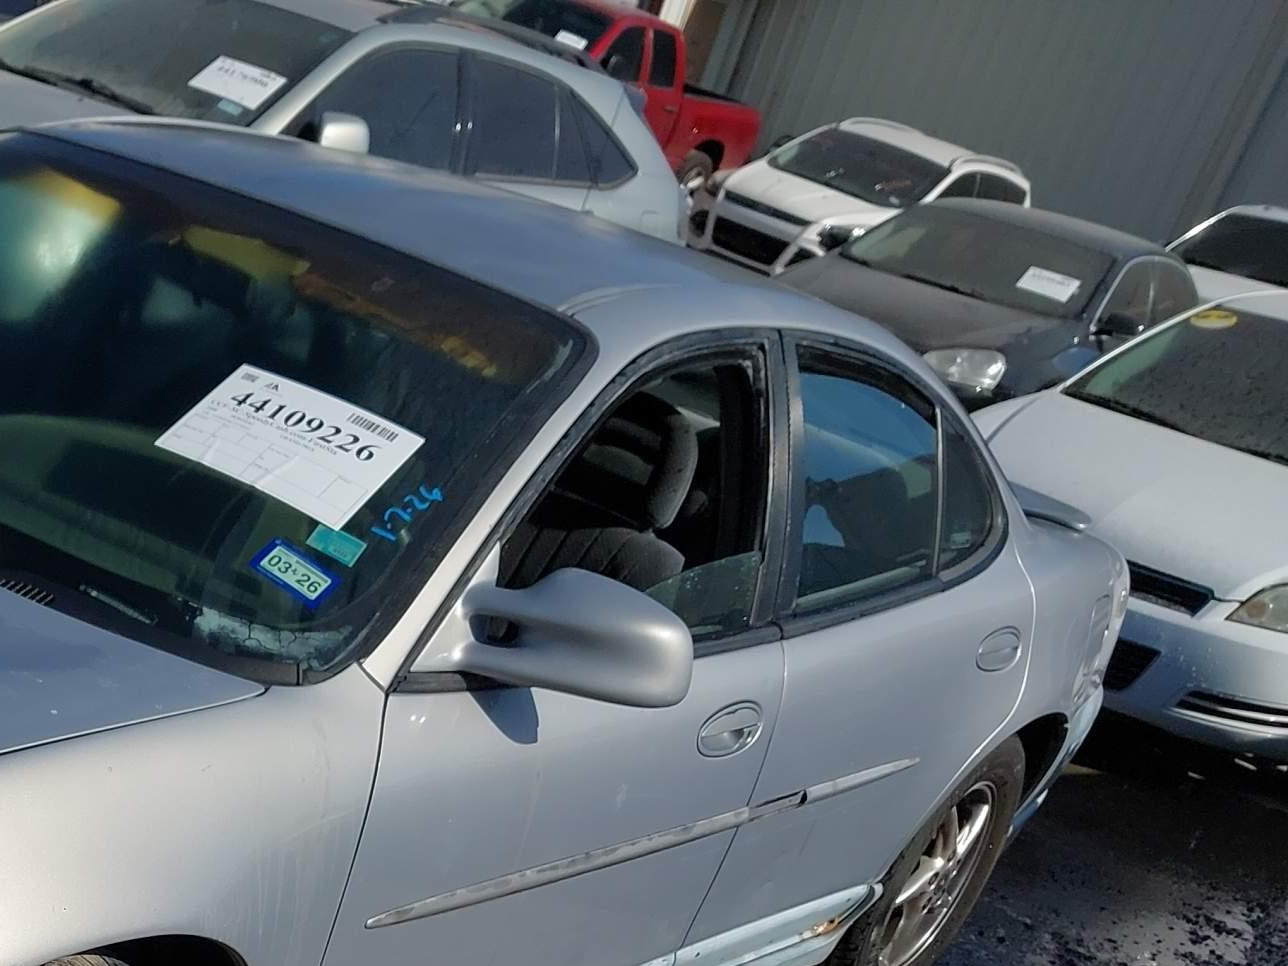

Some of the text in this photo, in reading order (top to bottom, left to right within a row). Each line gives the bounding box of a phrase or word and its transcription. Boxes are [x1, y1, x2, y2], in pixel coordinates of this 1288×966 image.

[230, 391, 376, 462] 44109226
[267, 554, 321, 594] 03 26
